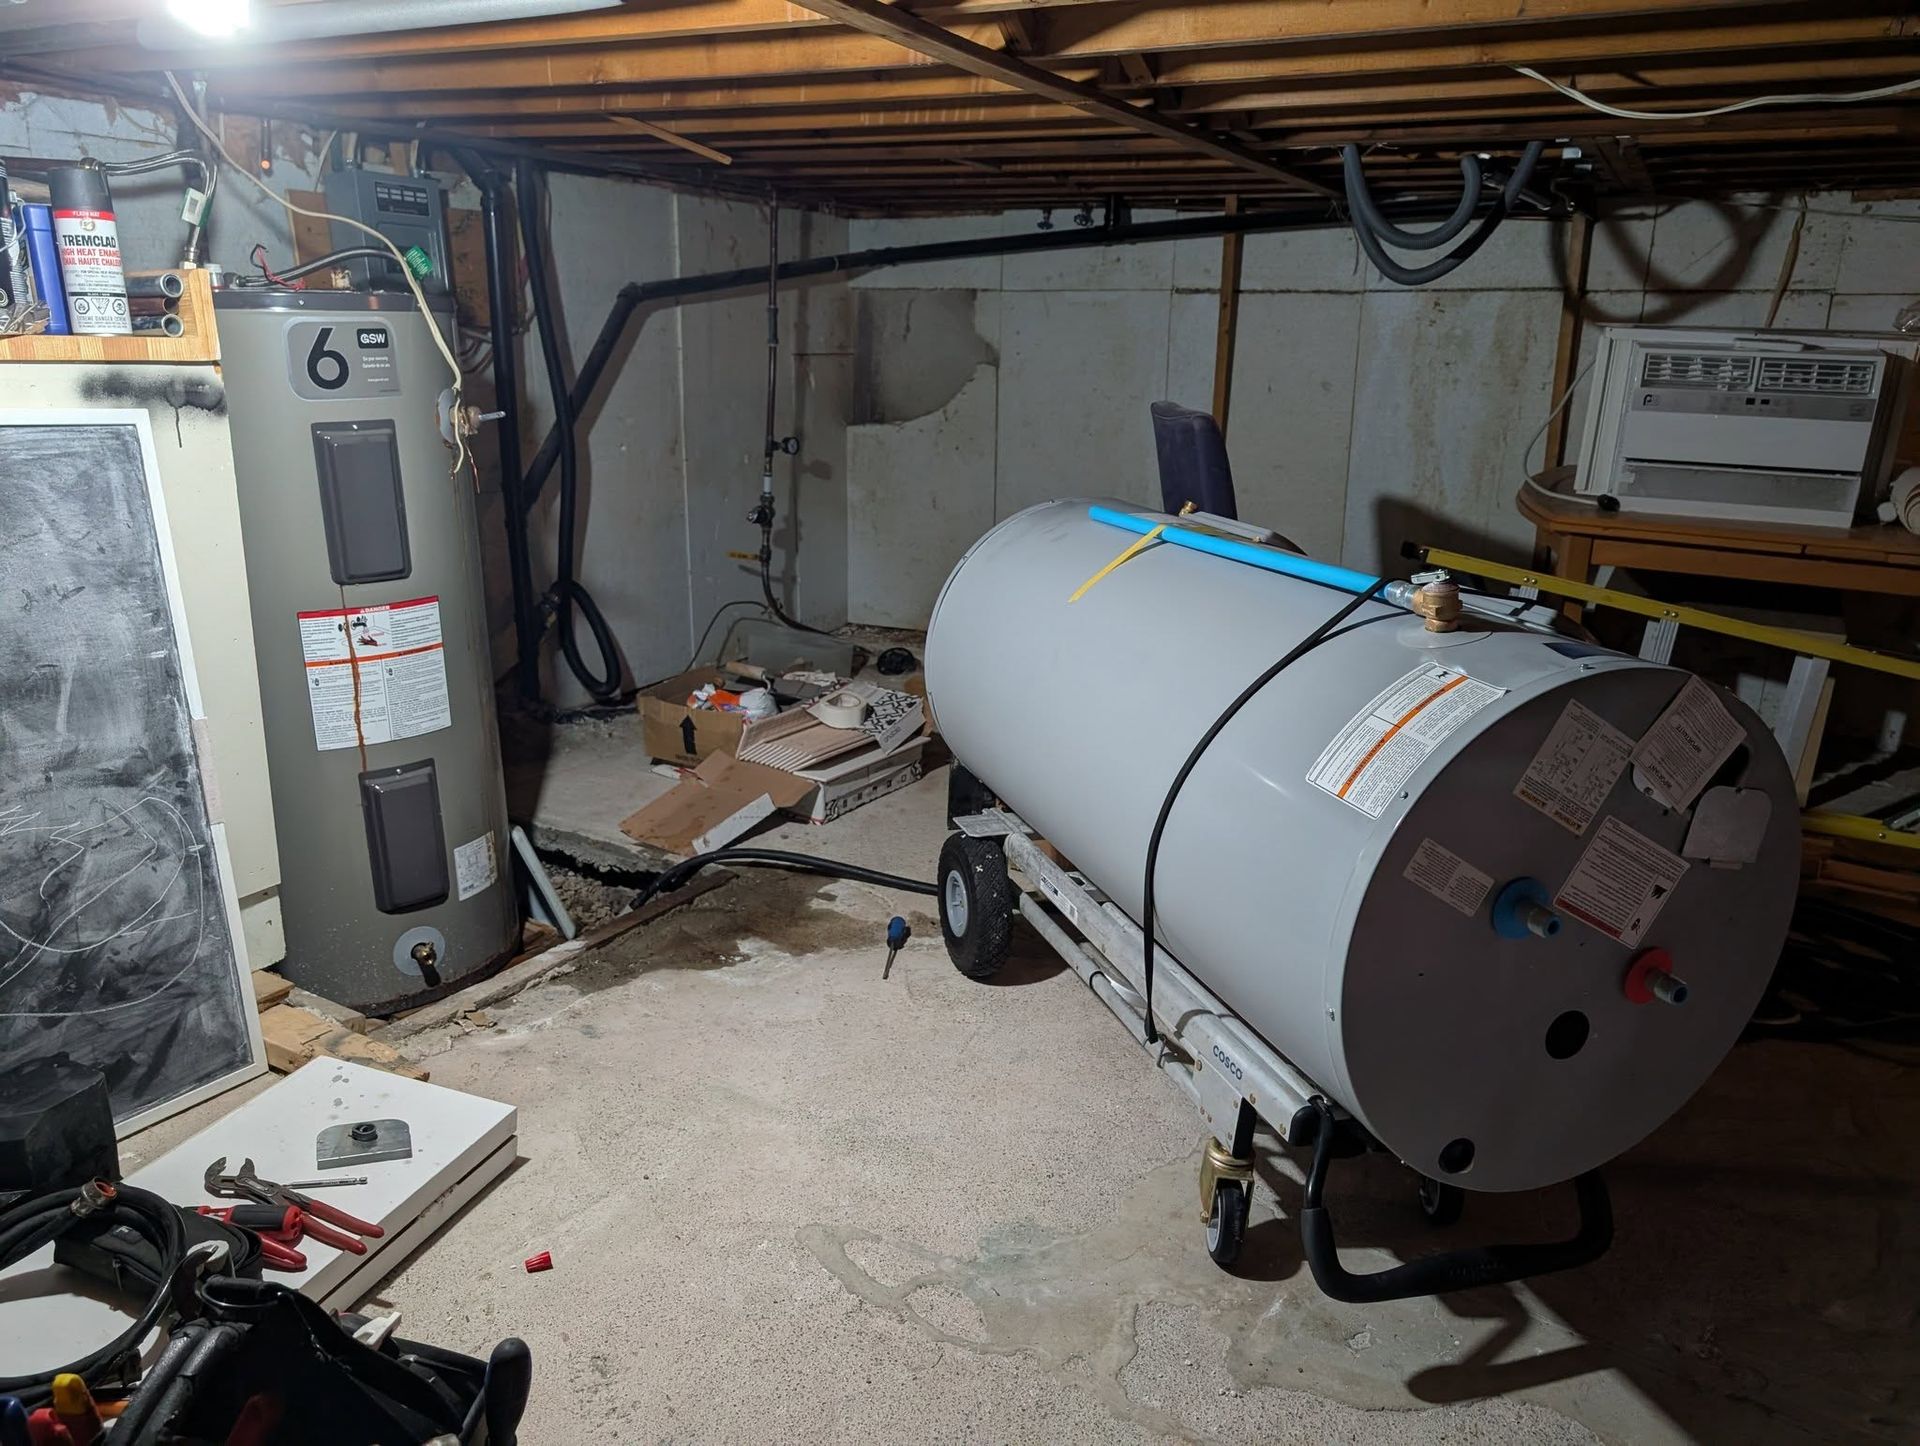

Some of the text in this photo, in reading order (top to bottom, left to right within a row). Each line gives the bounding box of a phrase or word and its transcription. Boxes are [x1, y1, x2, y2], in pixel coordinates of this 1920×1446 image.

[62, 234, 116, 248] TREMCLAD
[76, 248, 96, 256] HEAT
[98, 249, 120, 258] ENAME
[78, 258, 100, 266] HAUTE
[360, 334, 386, 344] GSW
[307, 327, 350, 390] 6
[1212, 1044, 1243, 1080] COSCO
